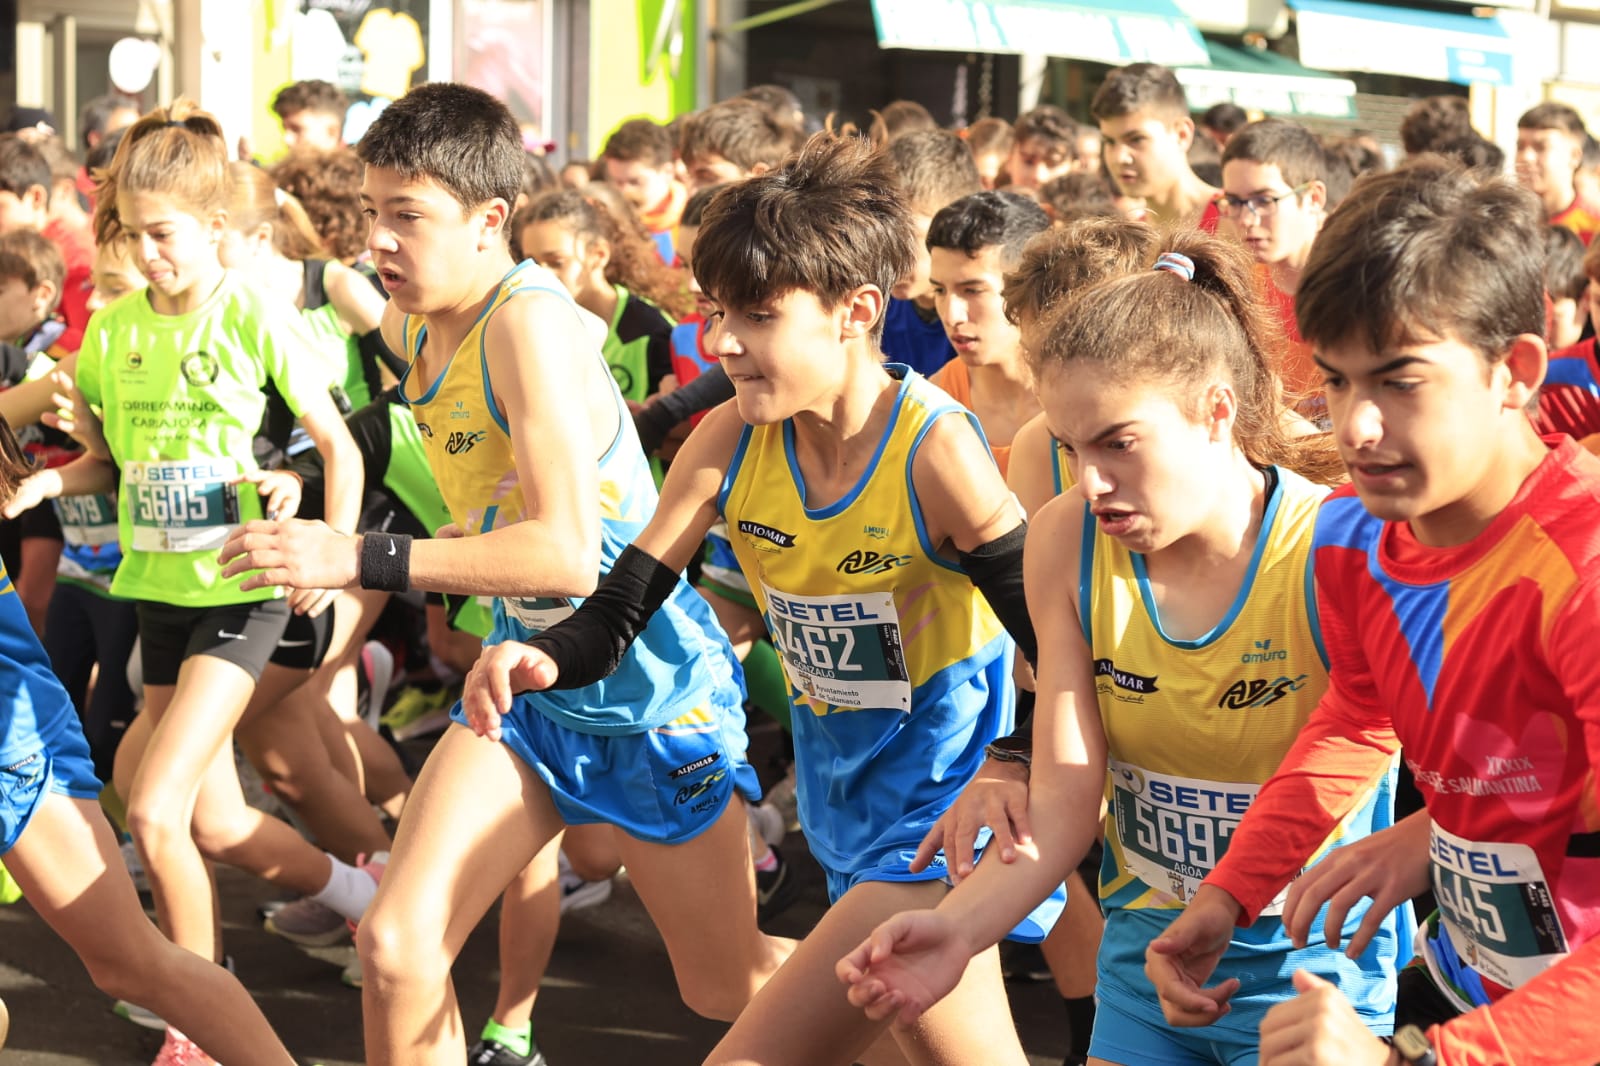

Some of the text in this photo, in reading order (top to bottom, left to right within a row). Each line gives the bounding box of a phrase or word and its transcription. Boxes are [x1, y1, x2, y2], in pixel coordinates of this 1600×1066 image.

[147, 465, 223, 480] SETEL
[138, 485, 208, 520] 5605
[741, 523, 787, 545] ALJOMAR
[769, 594, 879, 622] SETEL
[1241, 649, 1287, 664] amura
[793, 659, 835, 679] GONZALO
[1099, 661, 1144, 691] ALMAR
[816, 684, 859, 697] Ayuntamiento
[677, 756, 713, 775] ALJOMAR
[1149, 780, 1258, 814] SETE
[1174, 862, 1204, 879] AROA
[1434, 863, 1507, 943] 445
